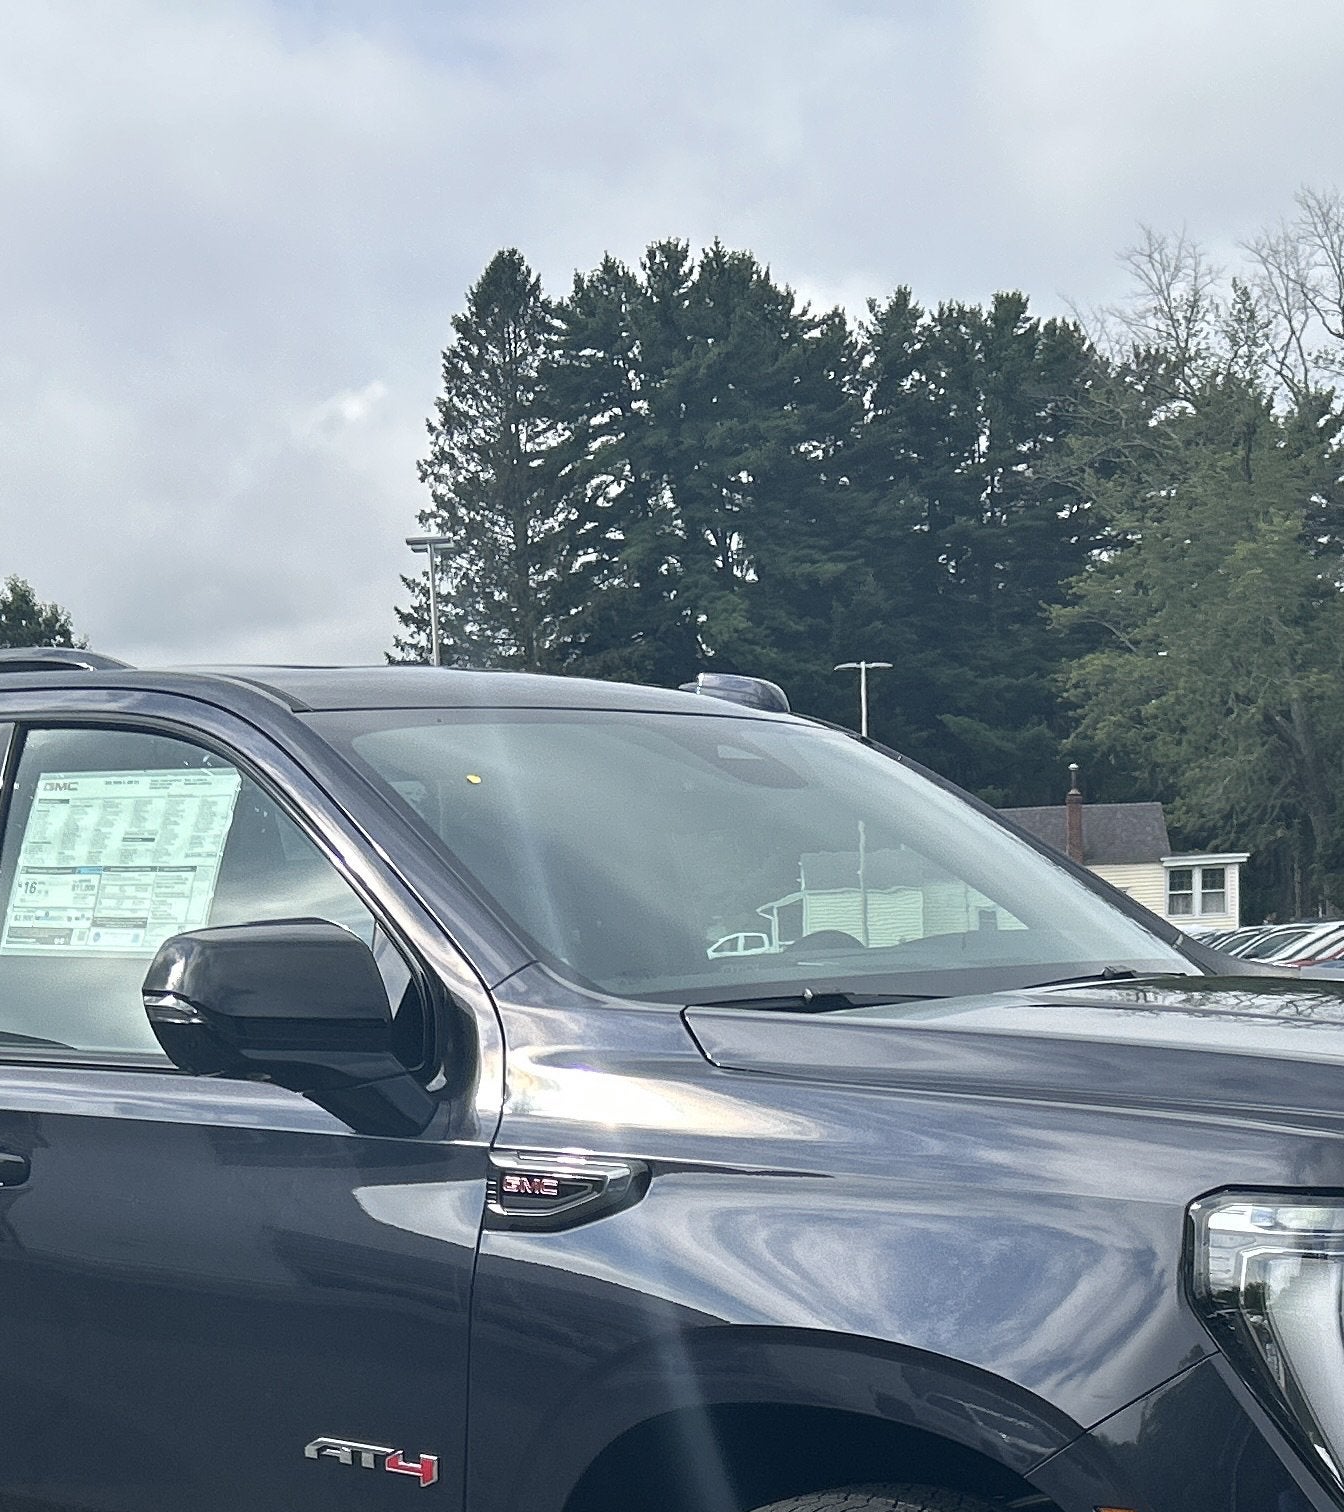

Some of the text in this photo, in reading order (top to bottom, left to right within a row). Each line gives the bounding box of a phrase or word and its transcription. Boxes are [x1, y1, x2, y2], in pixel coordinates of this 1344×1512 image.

[43, 781, 79, 792] GMC
[502, 1175, 559, 1196] GMC
[304, 1437, 438, 1487] AT4
